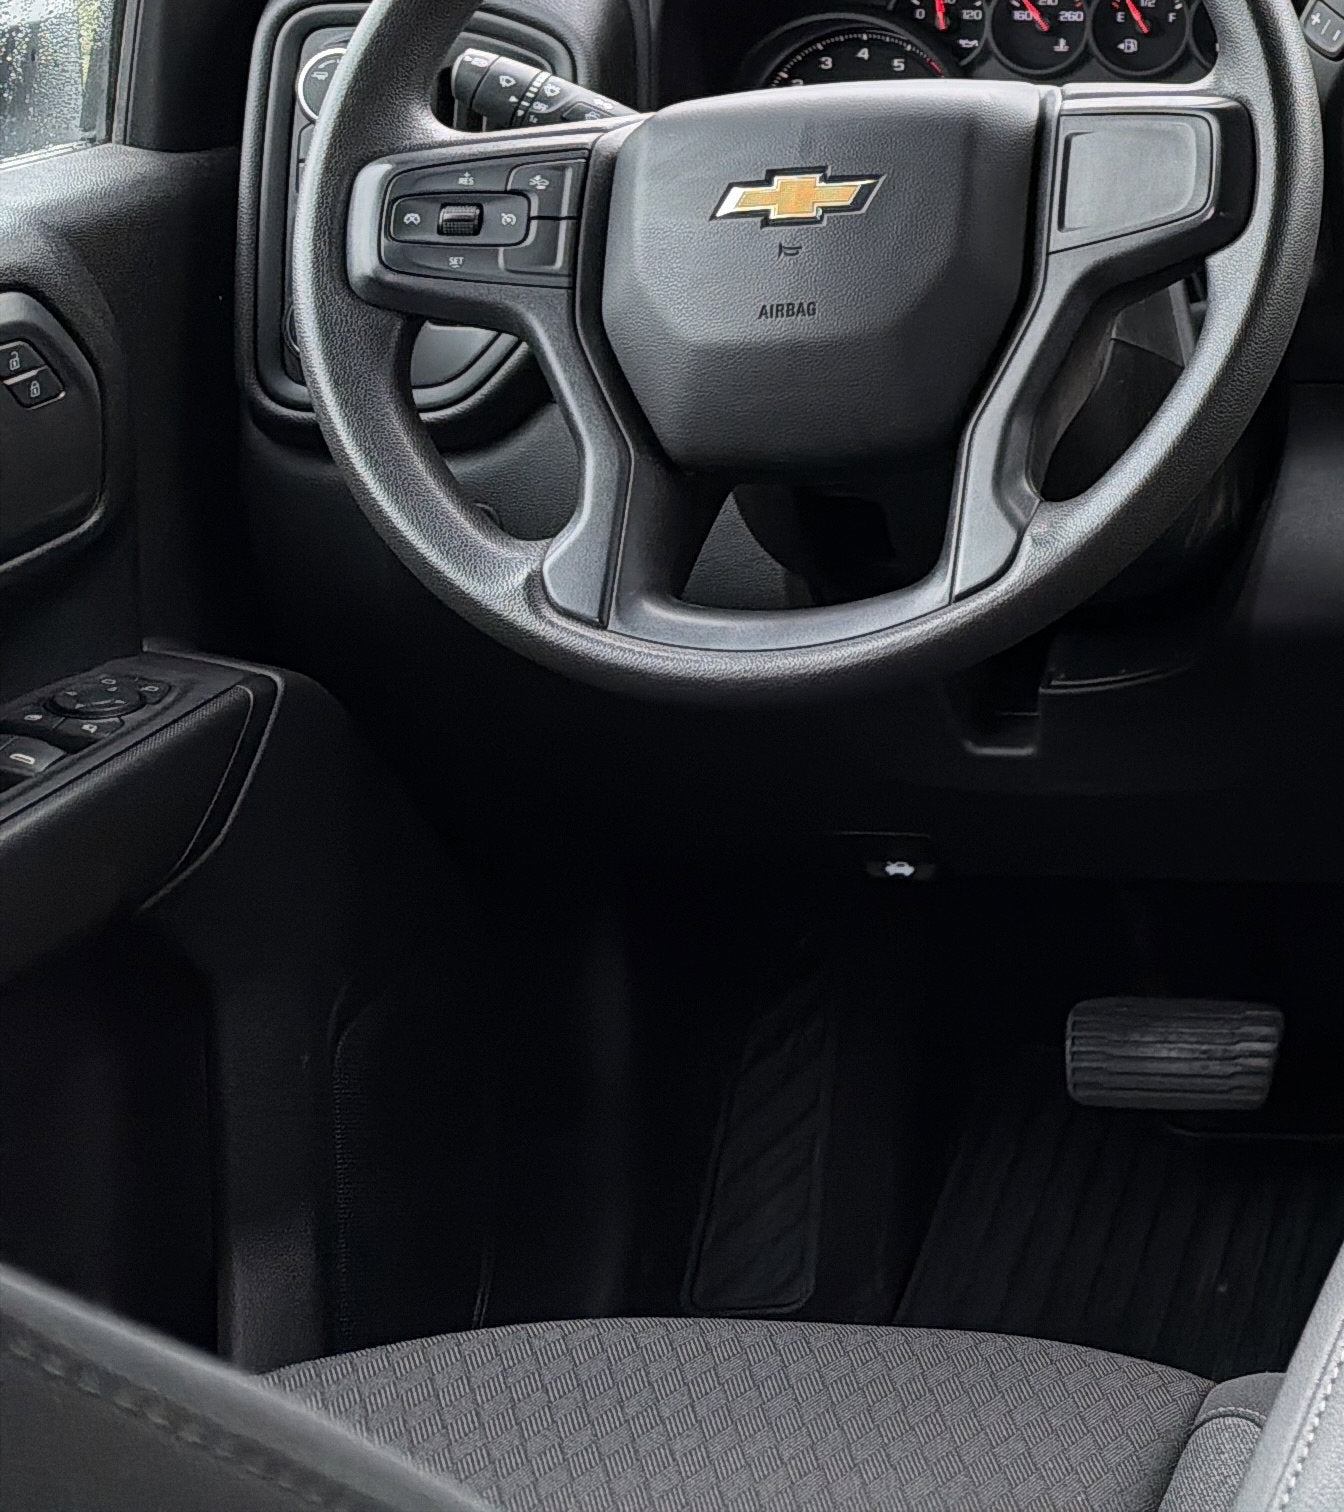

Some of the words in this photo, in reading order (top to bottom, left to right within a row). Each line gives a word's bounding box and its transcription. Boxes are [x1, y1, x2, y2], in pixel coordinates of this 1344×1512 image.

[915, 9, 925, 19] 0
[962, 9, 982, 20] 120
[1013, 10, 1033, 21] 160
[1059, 11, 1084, 21] 260
[1117, 13, 1125, 23] E
[1168, 13, 1176, 23] F
[856, 48, 869, 60] 4
[819, 57, 832, 70] 3
[893, 59, 905, 71] 5
[458, 177, 475, 186] RES
[449, 256, 464, 265] SET
[757, 301, 817, 320] AIRBAG
